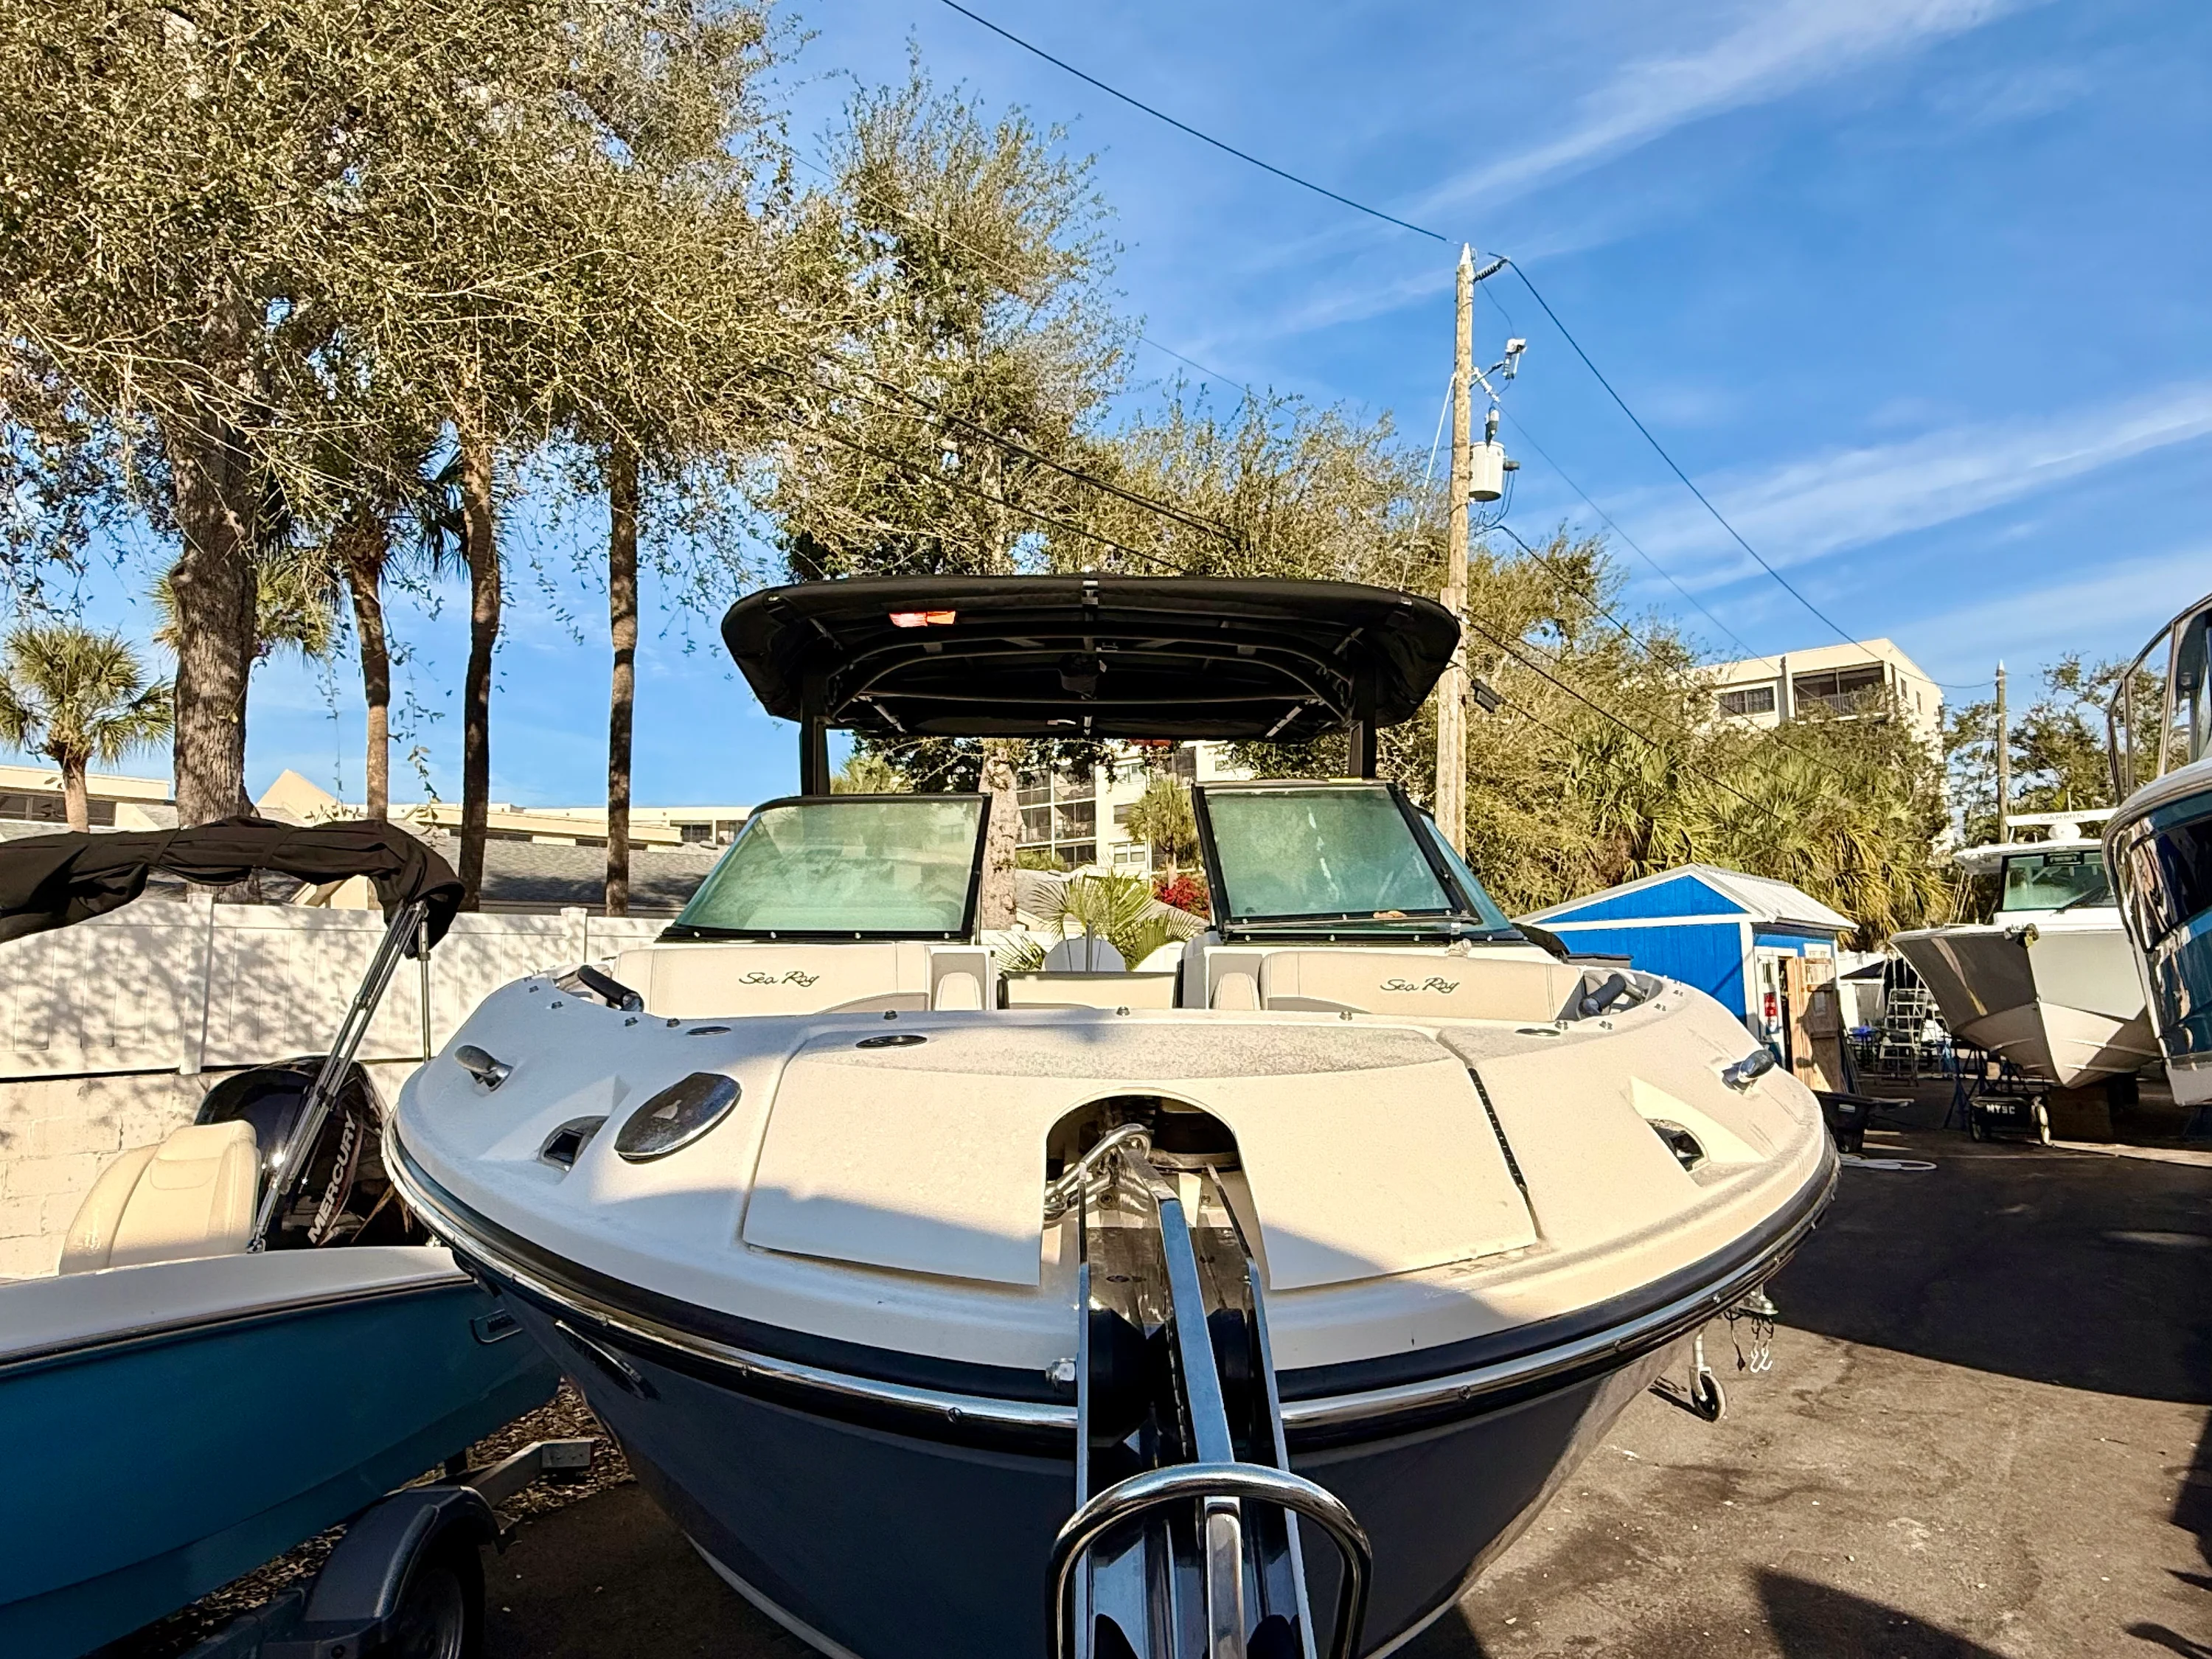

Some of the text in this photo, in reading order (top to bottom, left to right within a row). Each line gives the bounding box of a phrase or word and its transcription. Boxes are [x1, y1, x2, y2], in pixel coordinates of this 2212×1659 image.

[2039, 813, 2085, 821] GARMIN
[738, 970, 820, 987] Sea Ray
[1380, 977, 1460, 994] Sea Ray
[307, 1109, 356, 1244] MERCURY
